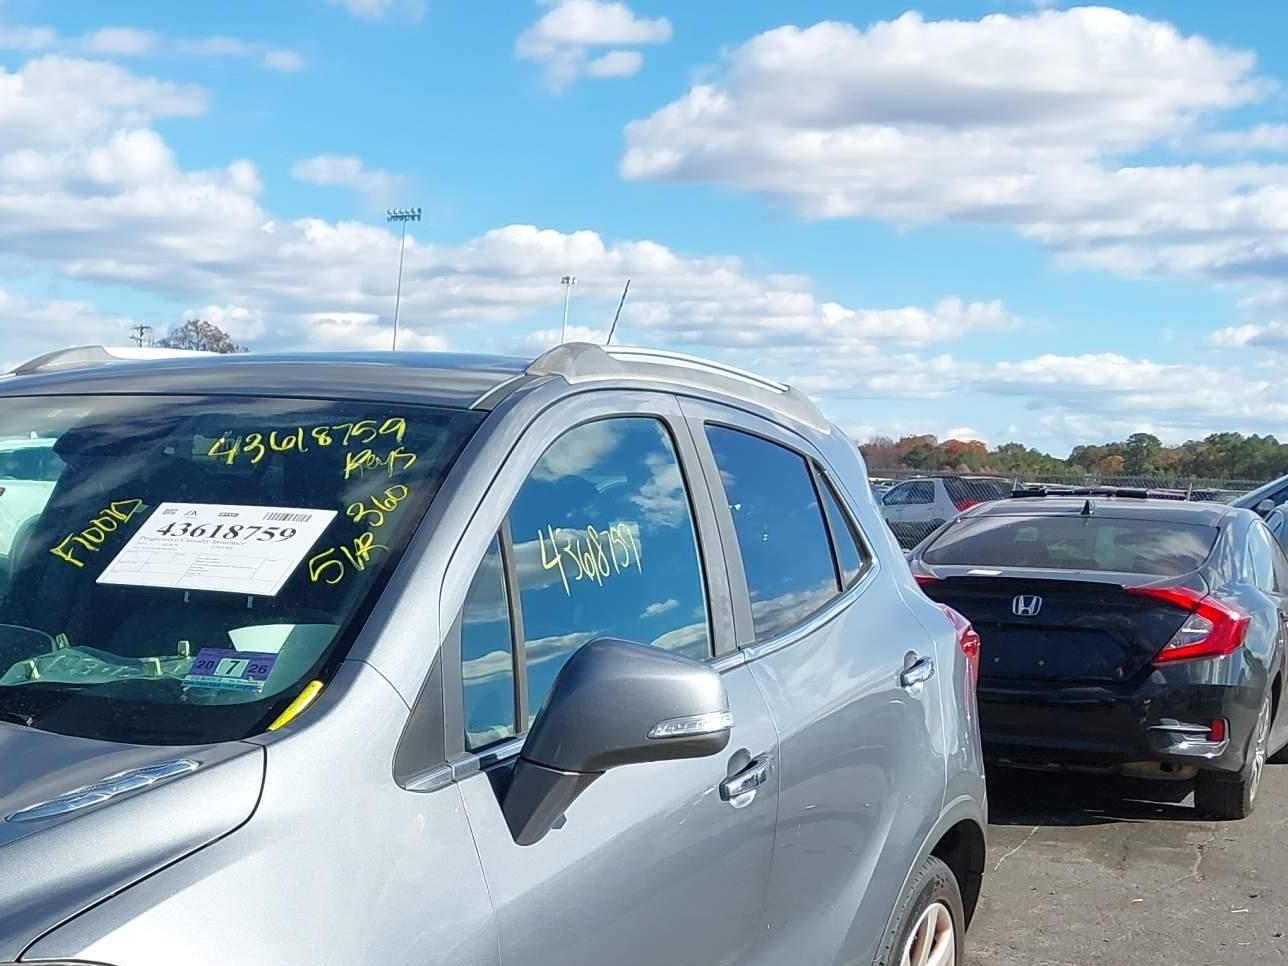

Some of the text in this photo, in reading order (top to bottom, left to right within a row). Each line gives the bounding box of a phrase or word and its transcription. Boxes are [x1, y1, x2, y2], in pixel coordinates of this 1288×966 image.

[208, 417, 406, 465] 43618759
[346, 484, 408, 527] 360
[156, 521, 297, 543] 43618759
[196, 660, 268, 675] 20 7 26
